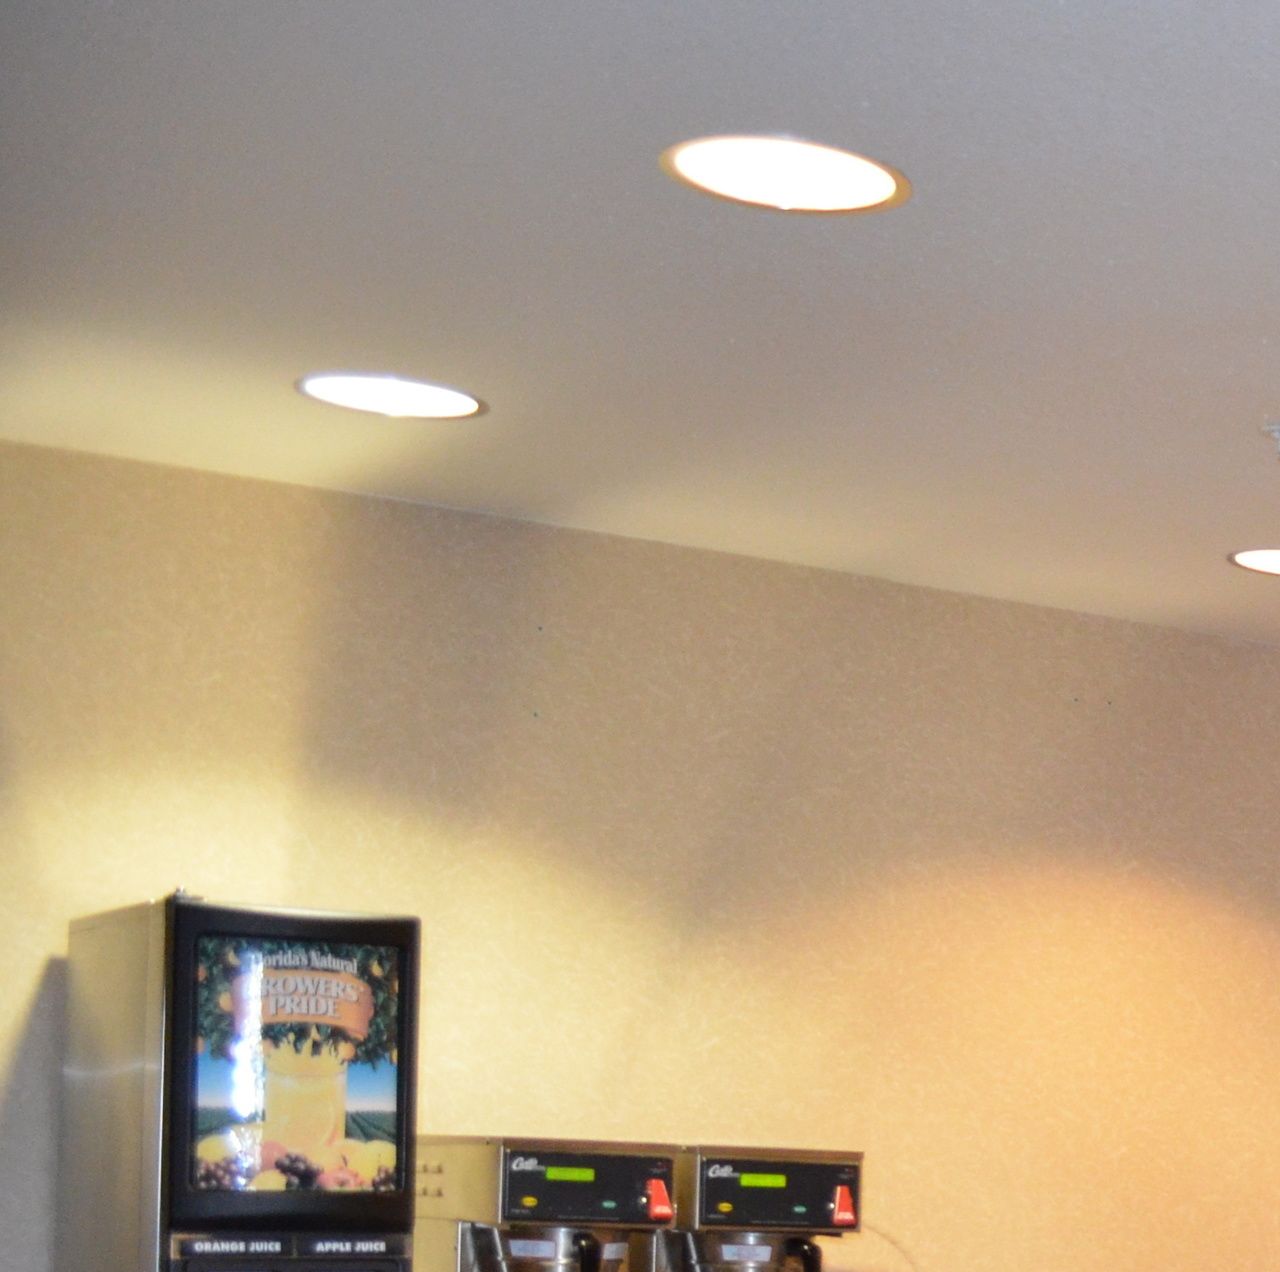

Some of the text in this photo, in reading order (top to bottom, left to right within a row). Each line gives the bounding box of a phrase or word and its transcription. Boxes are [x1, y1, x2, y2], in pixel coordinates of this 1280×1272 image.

[254, 950, 358, 974] orida's Natural
[258, 975, 364, 1002] ROWERS'
[269, 994, 341, 1018] PRIDE
[194, 1241, 282, 1253] ORANGE JUICE
[315, 1241, 386, 1253] APPLE JUICE
